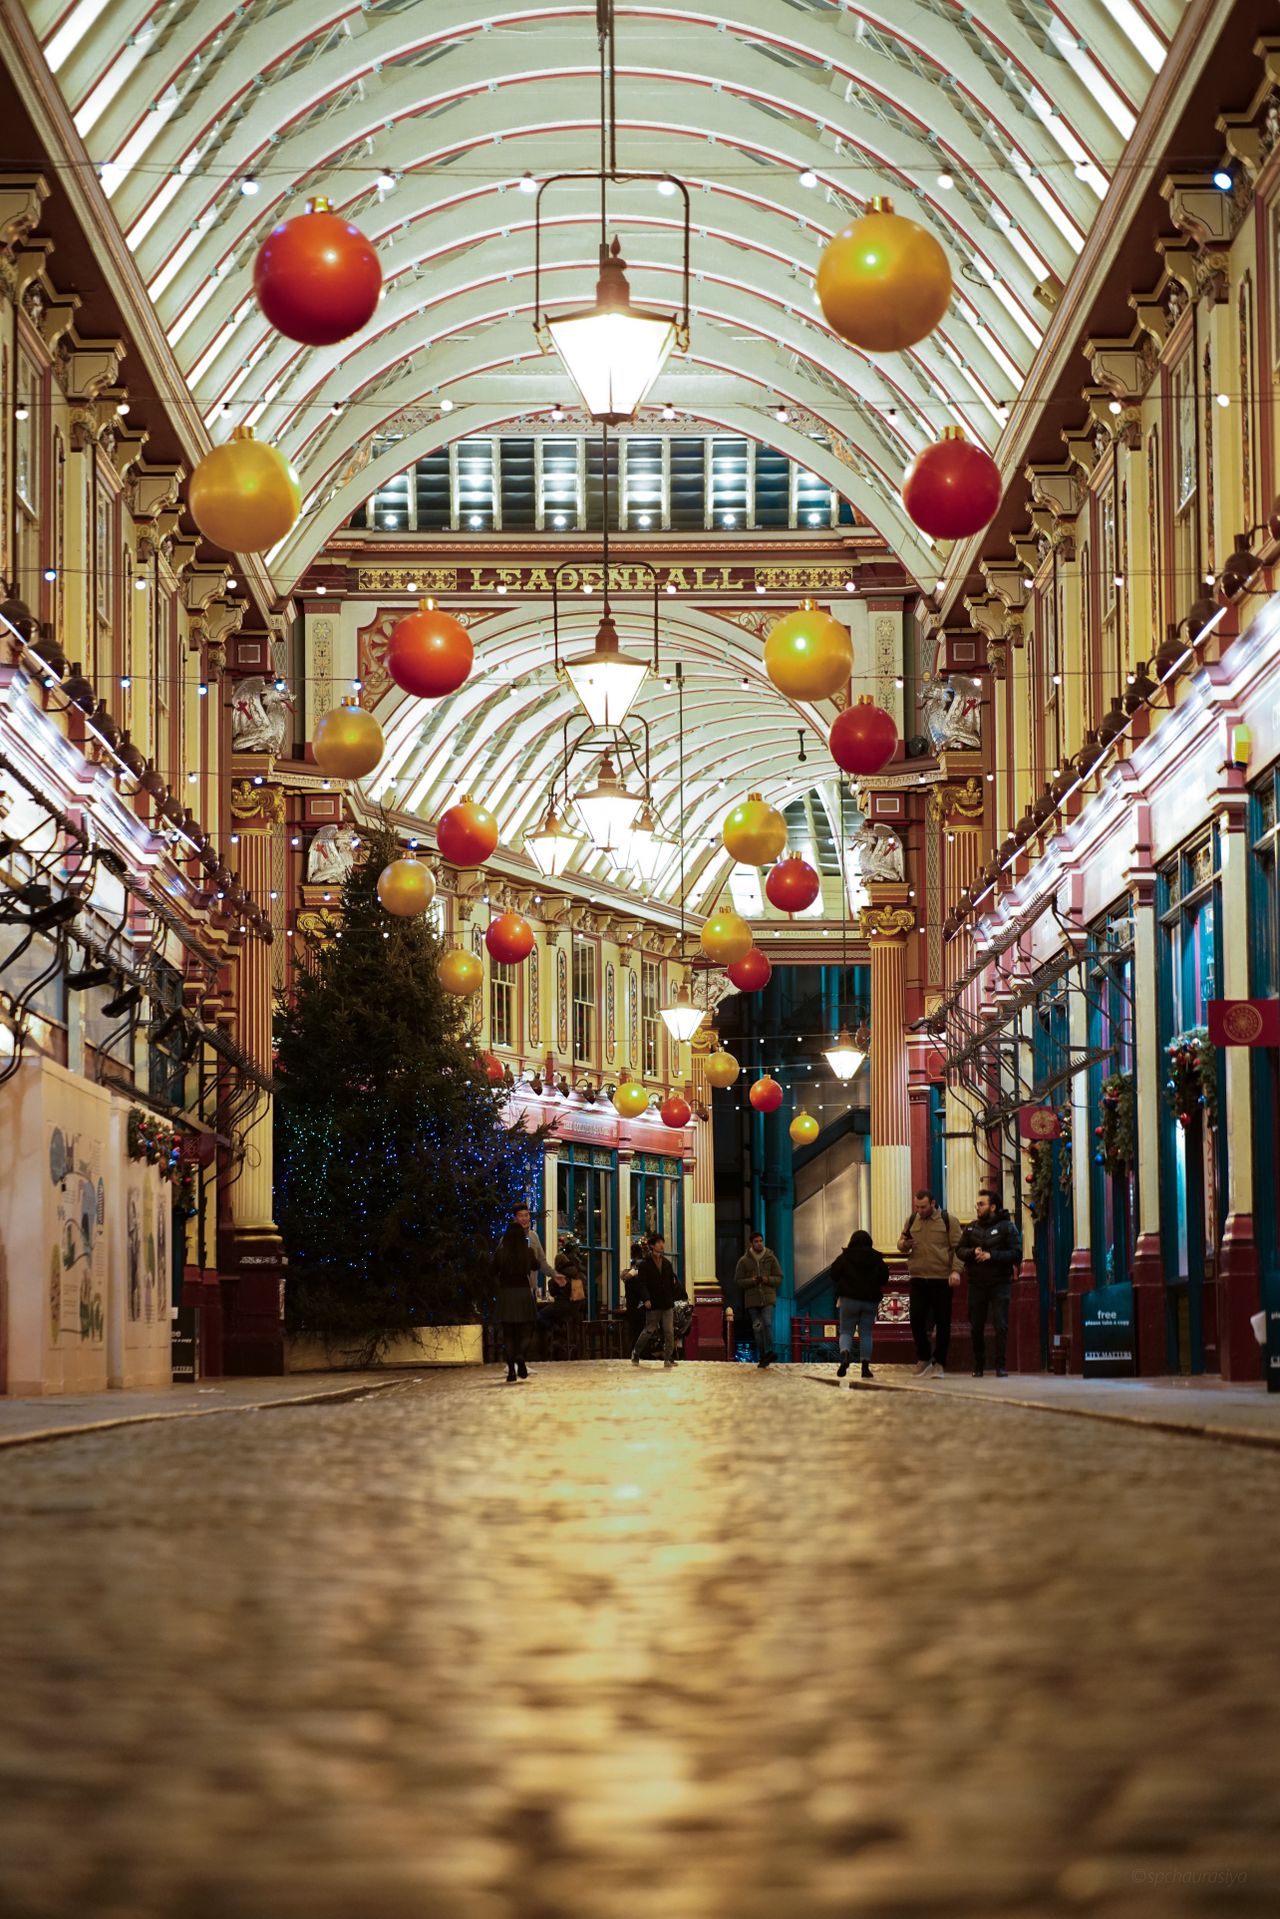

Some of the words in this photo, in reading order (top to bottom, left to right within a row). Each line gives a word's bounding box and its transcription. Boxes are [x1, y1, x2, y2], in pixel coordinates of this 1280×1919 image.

[470, 568, 744, 590] LEADENHALL
[1097, 1309, 1117, 1319] free
[1085, 1351, 1100, 1360] CITY
